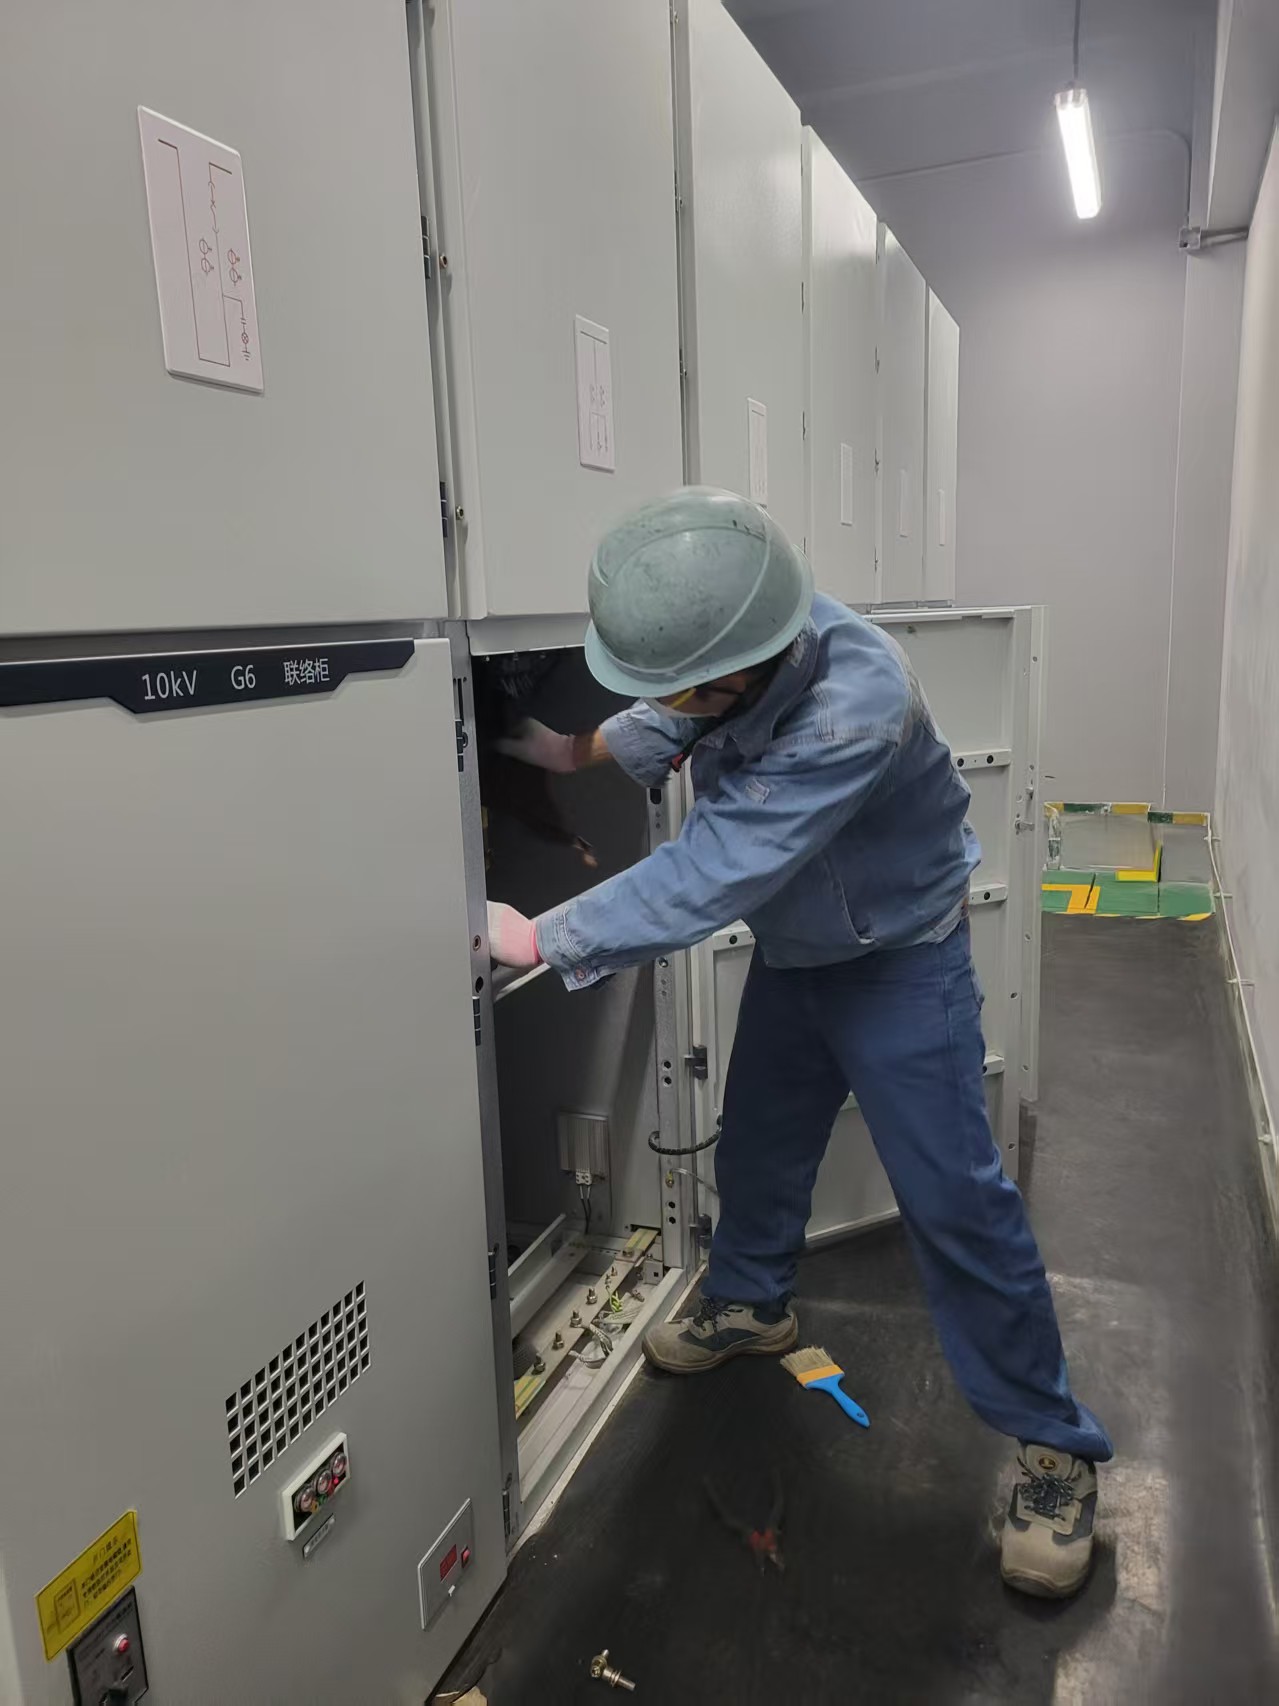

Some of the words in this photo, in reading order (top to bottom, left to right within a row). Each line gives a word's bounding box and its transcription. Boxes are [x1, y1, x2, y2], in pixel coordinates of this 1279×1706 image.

[142, 670, 197, 701] 10kV
[231, 665, 256, 690] G6
[283, 658, 330, 686] 联络柜
